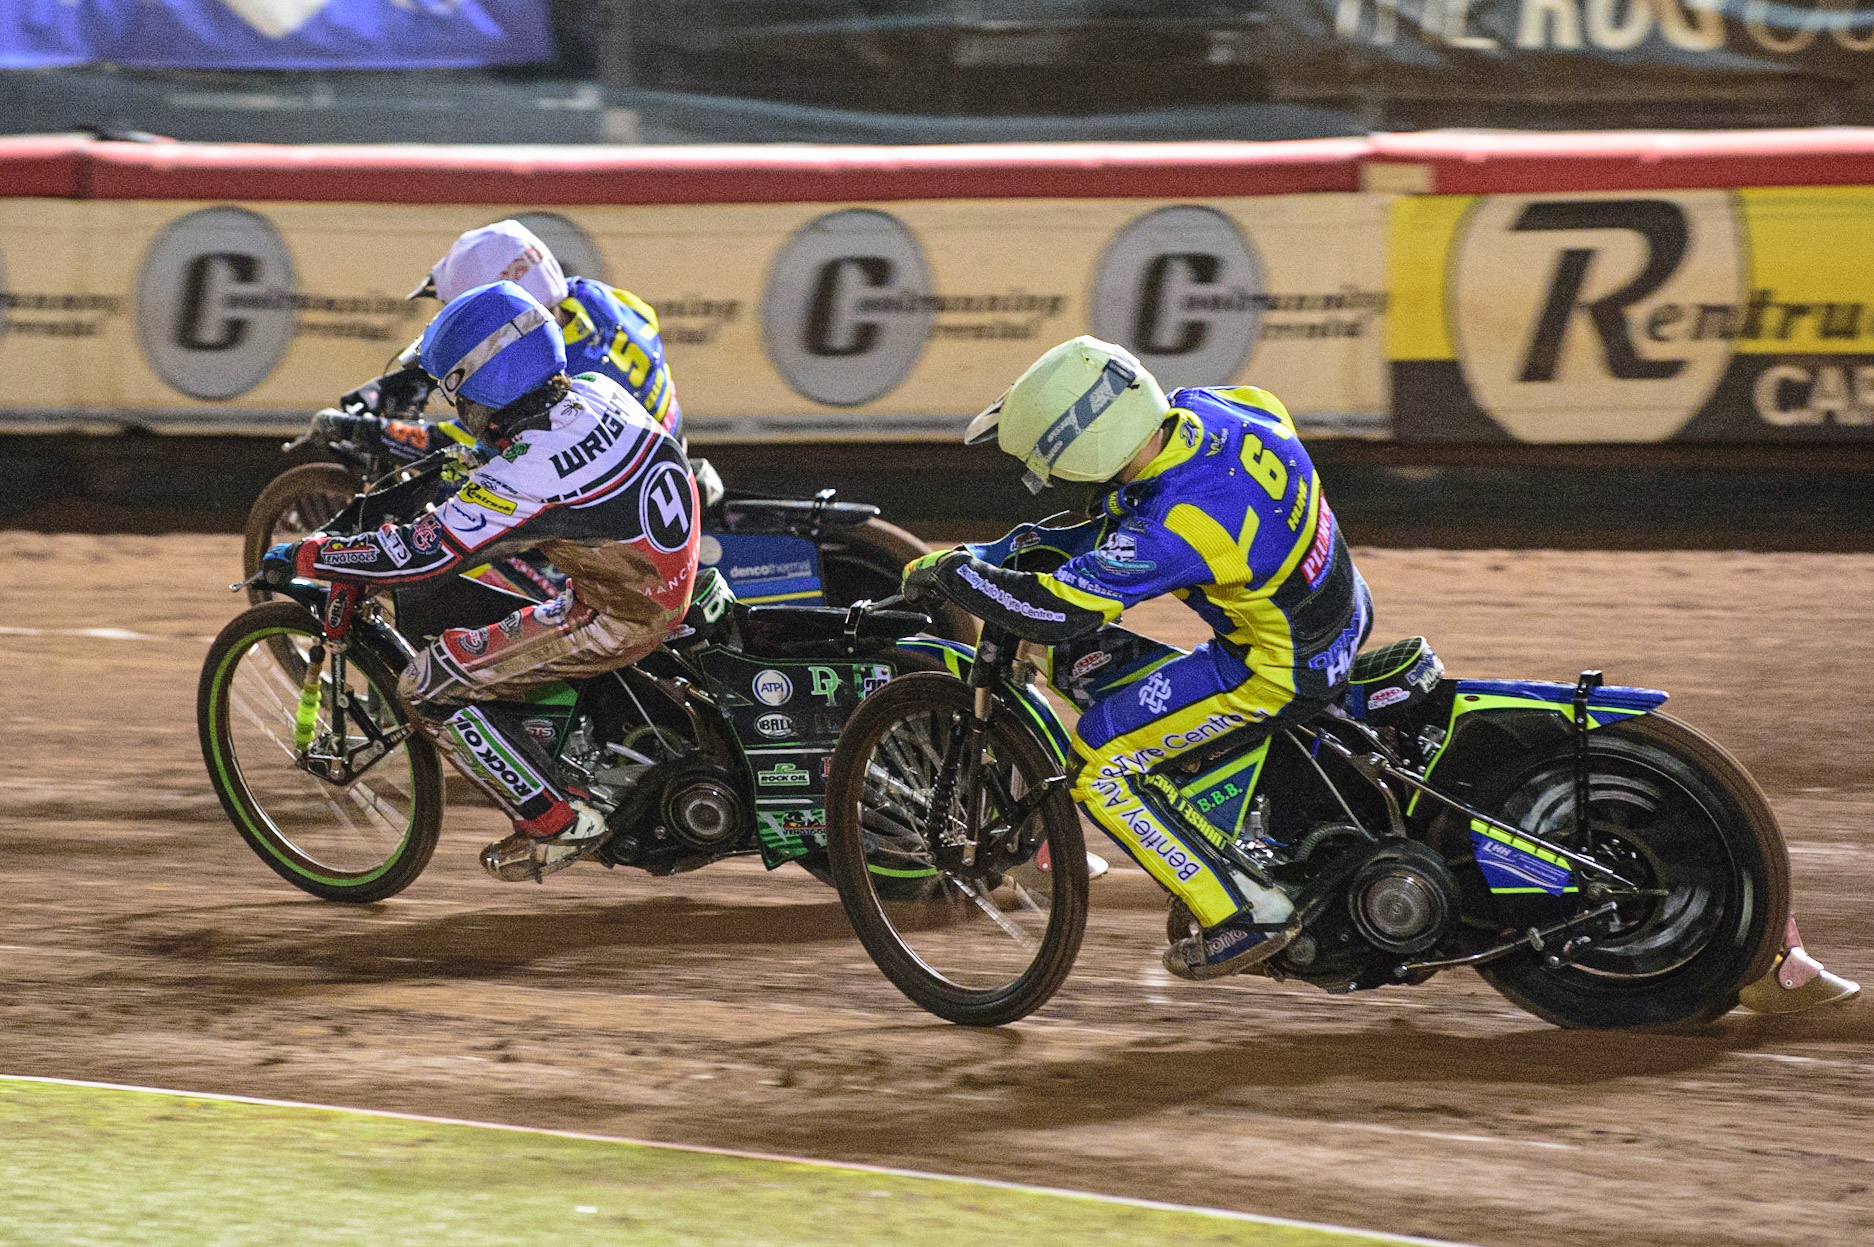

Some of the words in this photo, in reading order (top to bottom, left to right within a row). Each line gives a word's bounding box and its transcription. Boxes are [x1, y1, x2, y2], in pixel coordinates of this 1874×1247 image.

[1507, 200, 1874, 383] Rentru
[608, 331, 651, 388] 5
[1239, 433, 1288, 501] 6
[650, 471, 689, 533] 4
[1021, 604, 1053, 620] Centre
[760, 681, 784, 693] ATPI
[1165, 713, 1243, 749] Centre
[477, 747, 533, 797] ROCK
[1114, 747, 1165, 772] Tyre
[1197, 782, 1244, 813] B.B.B.
[1122, 808, 1200, 881] Bentley
